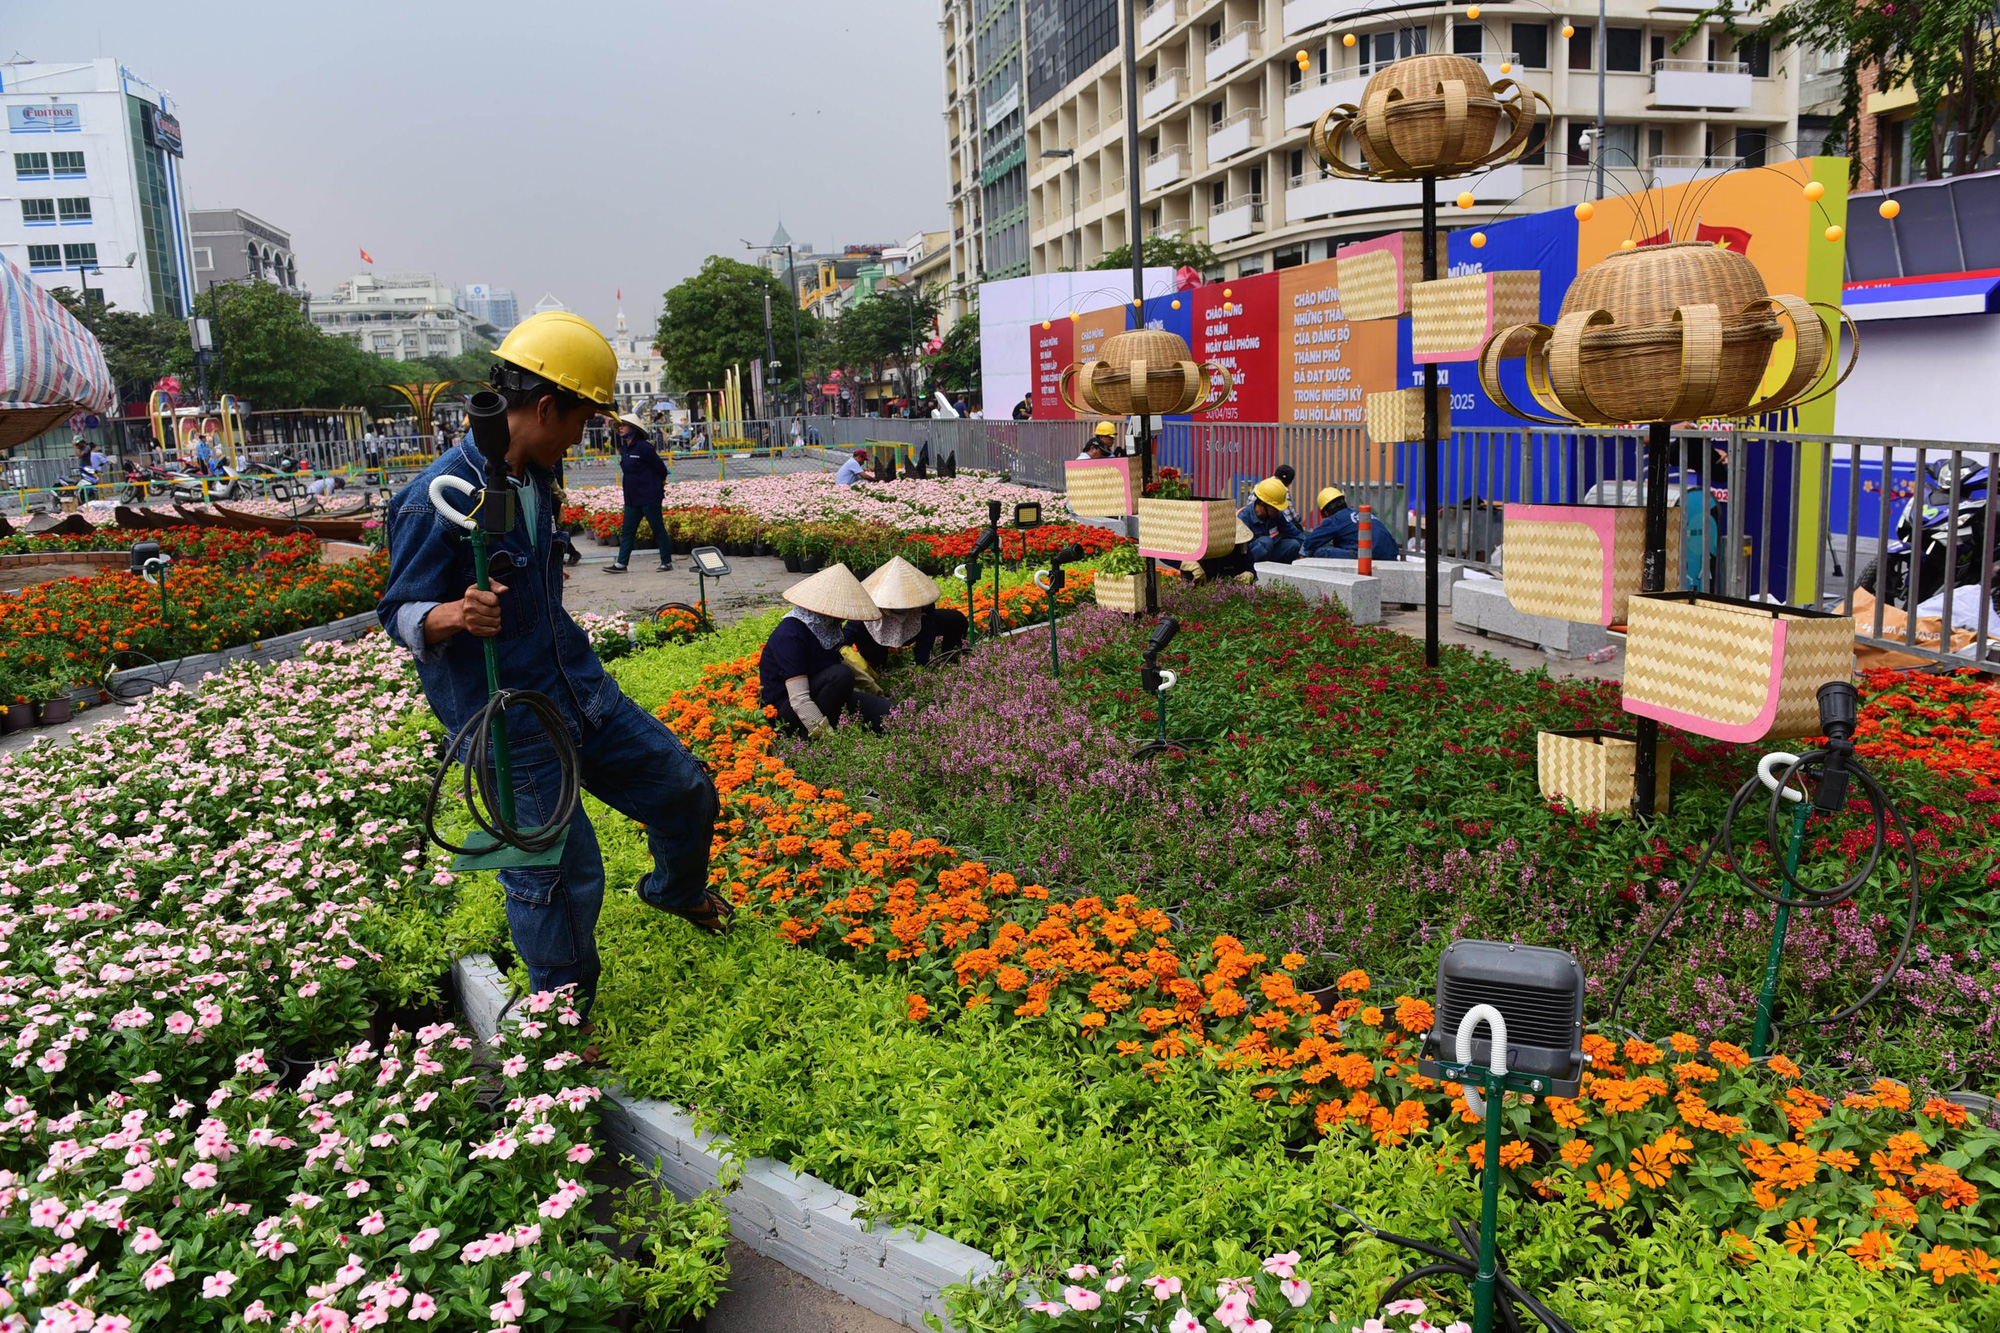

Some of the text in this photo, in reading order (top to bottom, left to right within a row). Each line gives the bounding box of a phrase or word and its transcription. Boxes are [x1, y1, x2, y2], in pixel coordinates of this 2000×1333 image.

[23, 106, 73, 120] FIDITOUR
[1294, 289, 1316, 307] CHÀO
[1205, 304, 1222, 320] CHÀO
[1294, 309, 1323, 326] NHỮNG
[1205, 321, 1228, 337] 45 NĂM
[1294, 324, 1350, 346] CỦA ĐẢNG BỘ
[1205, 338, 1222, 354] NGÀY
[1236, 334, 1260, 351] PHÓNG
[1294, 343, 1341, 364] THÀNH PHỐ
[1294, 367, 1352, 386] ĐÃ ĐẠT ĐƯỢC
[1294, 389, 1321, 402] TRONG
[1322, 386, 1349, 404] NHIỆM
[1294, 409, 1308, 424] ĐẠI
[1309, 405, 1323, 424] HỘI
[1324, 403, 1342, 422] LẦN
[1343, 405, 1363, 422] THỨ
